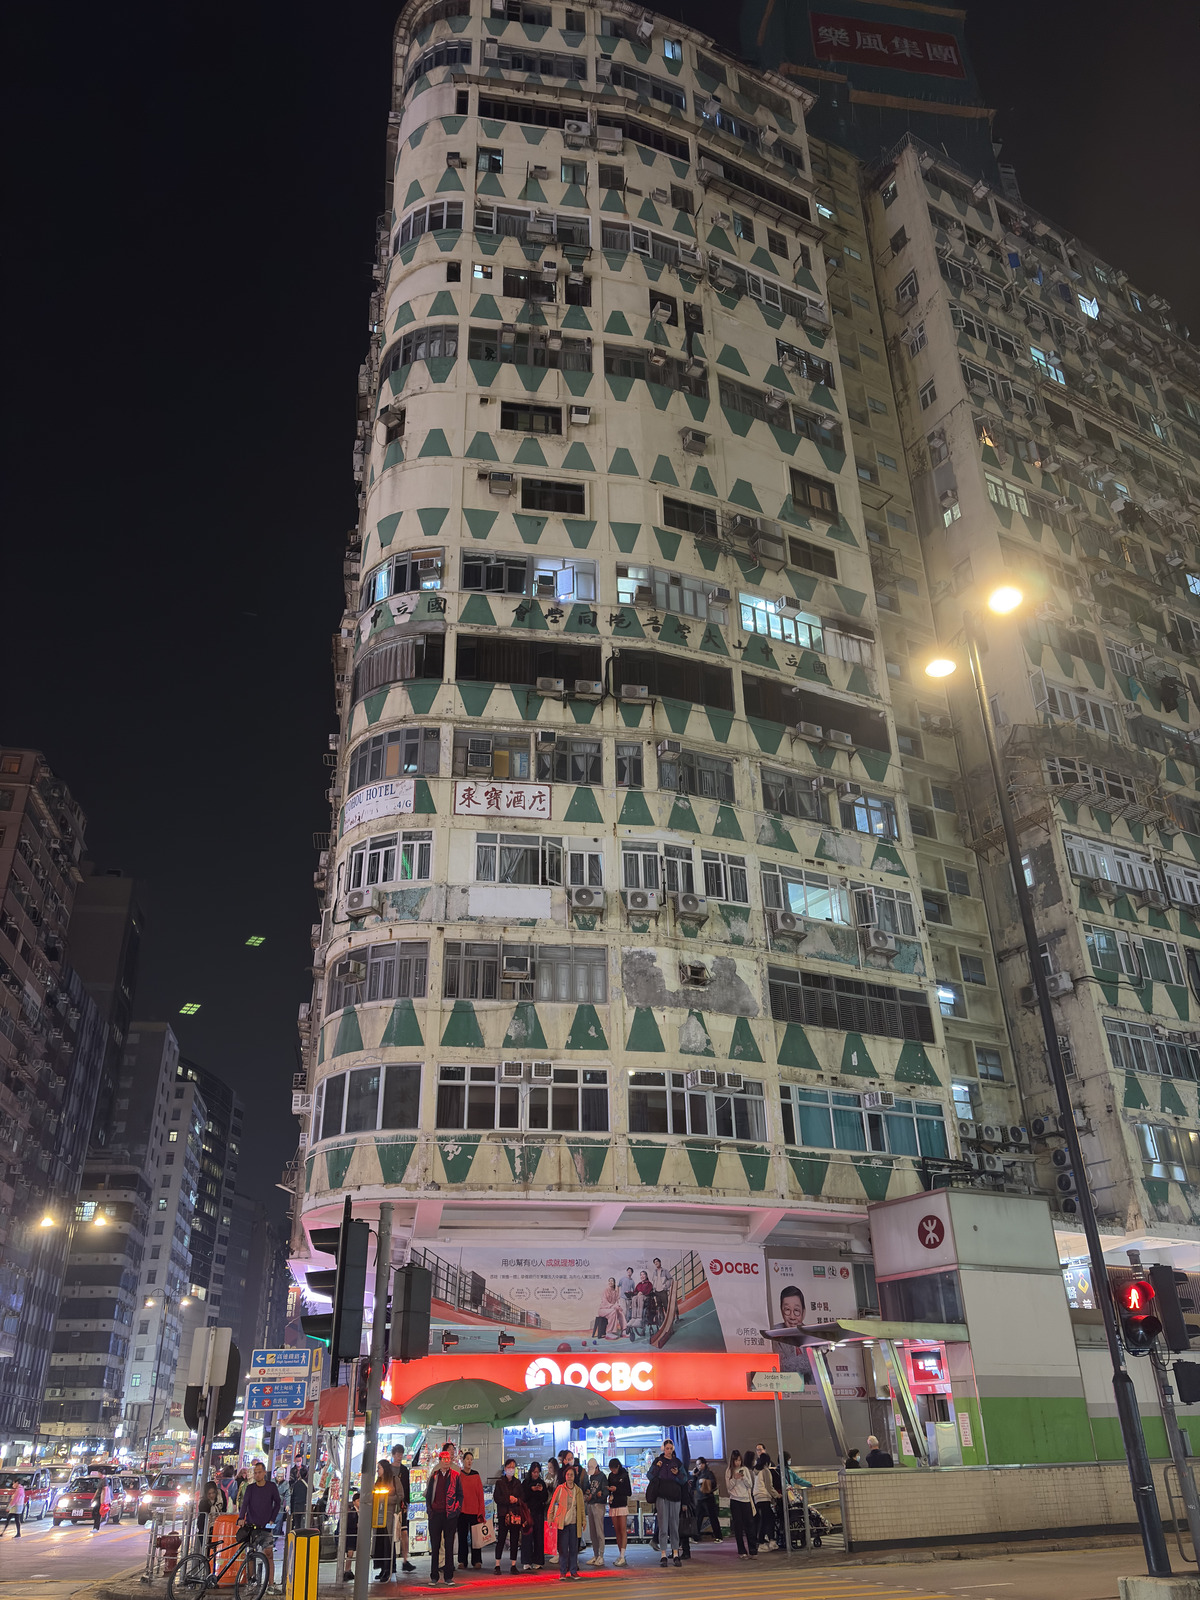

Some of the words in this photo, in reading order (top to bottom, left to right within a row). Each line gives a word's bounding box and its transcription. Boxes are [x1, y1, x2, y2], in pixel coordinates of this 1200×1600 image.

[817, 26, 959, 65] 樂風集團
[366, 783, 396, 802] HOTEL
[458, 786, 547, 812] 東寶酒店
[724, 1261, 759, 1275] OCBC
[563, 1361, 654, 1392] OCBC
